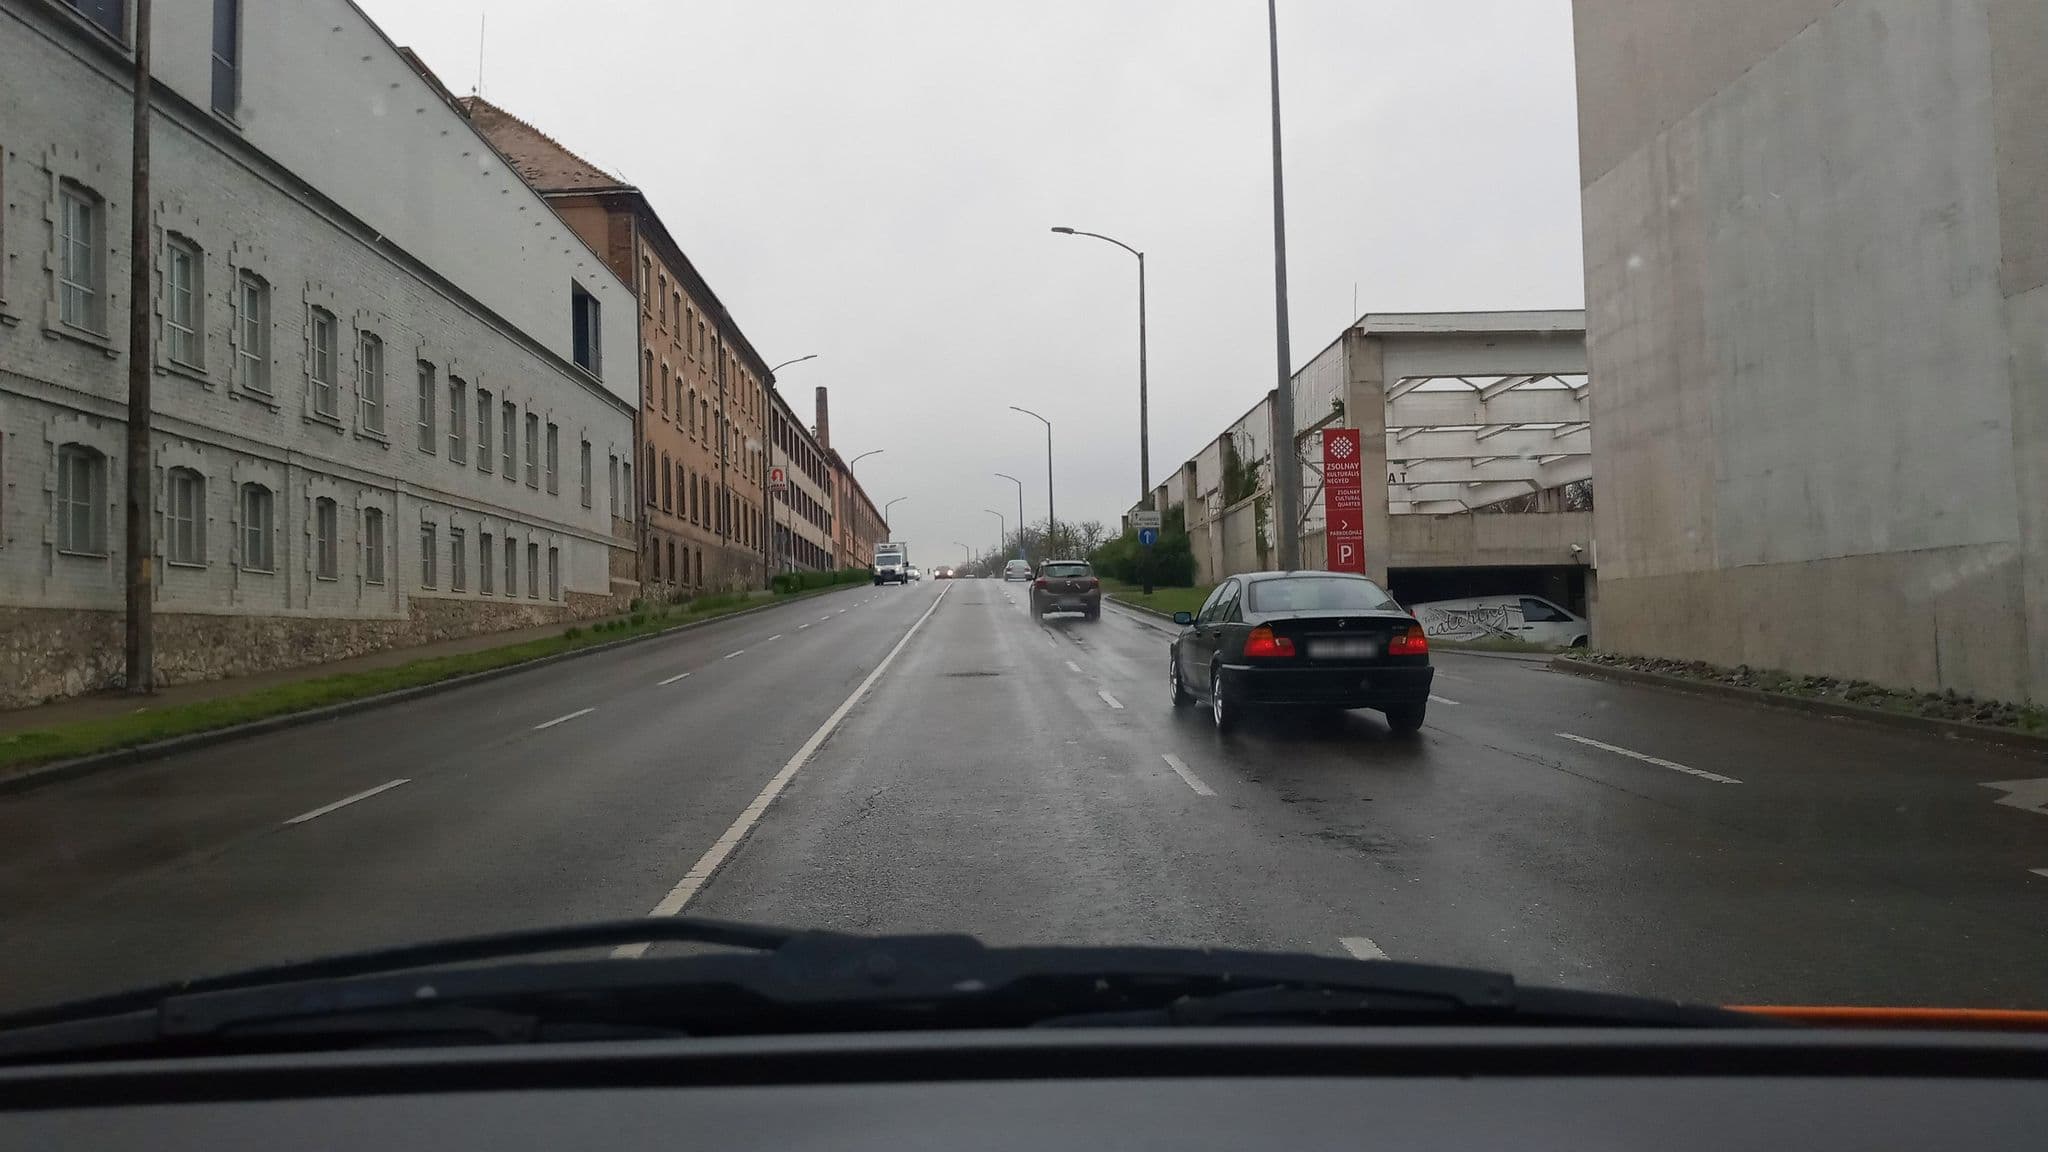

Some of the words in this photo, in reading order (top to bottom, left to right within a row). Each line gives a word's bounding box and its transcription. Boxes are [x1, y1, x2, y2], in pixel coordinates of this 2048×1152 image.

[1327, 462, 1359, 470] ZSOLNAY
[1340, 545, 1352, 564] P
[1428, 604, 1508, 636] catering
